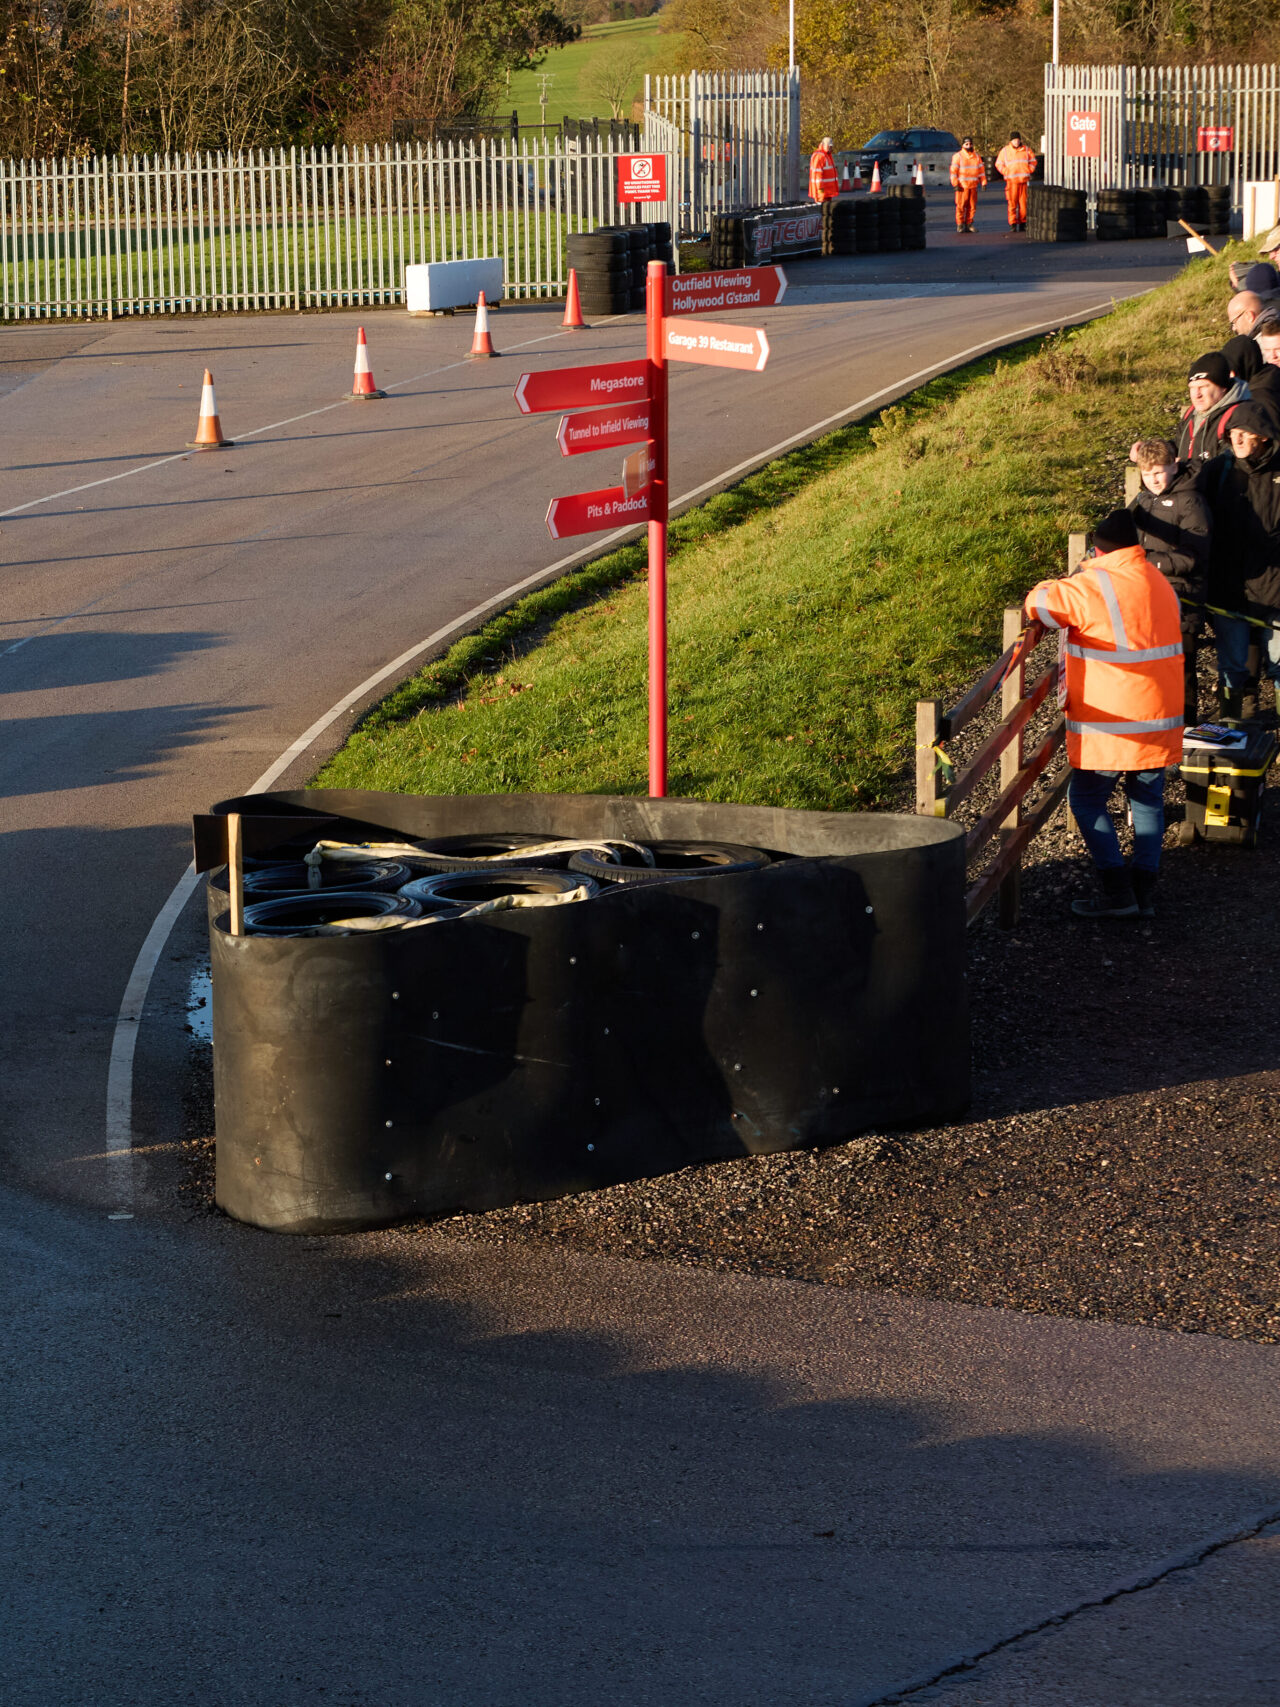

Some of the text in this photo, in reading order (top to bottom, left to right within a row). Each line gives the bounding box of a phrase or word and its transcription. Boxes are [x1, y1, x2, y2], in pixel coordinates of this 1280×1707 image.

[1070, 115, 1097, 131] Gate
[1078, 133, 1087, 153] 1
[672, 274, 751, 292] Outfield Viewing
[673, 295, 724, 310] Hollywood
[668, 332, 754, 354] Garage 39 Restaurant
[590, 376, 644, 392] Megastore
[569, 415, 649, 440] Tunnel to Infield Viewing
[587, 496, 647, 518] Pits & Paddock
